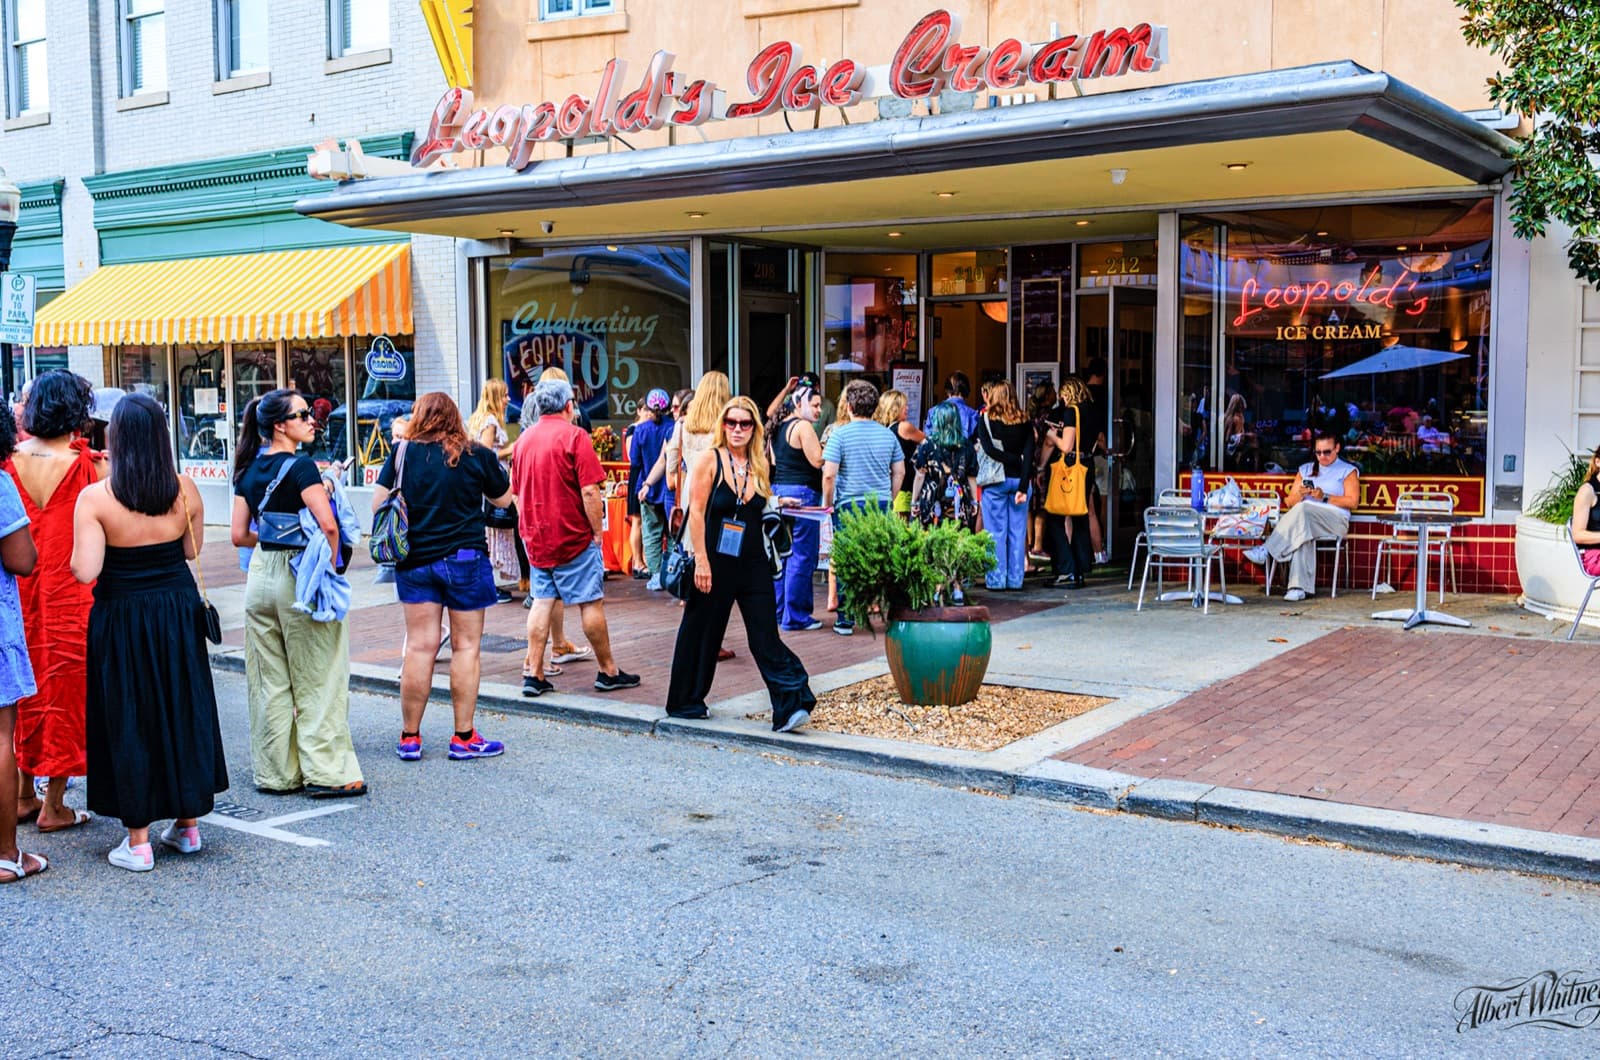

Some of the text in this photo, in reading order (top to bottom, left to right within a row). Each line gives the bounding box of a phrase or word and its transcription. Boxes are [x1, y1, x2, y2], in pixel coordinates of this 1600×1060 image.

[410, 9, 1162, 170] Leopold's Ice Cream
[752, 263, 776, 279] 208
[954, 265, 984, 282] 210
[1105, 256, 1140, 274] 212
[11, 293, 24, 301] PAY
[1233, 265, 1429, 327] Leopold's
[8, 310, 26, 319] PARK
[511, 300, 660, 347] Celebrating
[1276, 325, 1382, 341] ICE CREAM
[562, 340, 640, 389] 105
[611, 393, 637, 415] Ye
